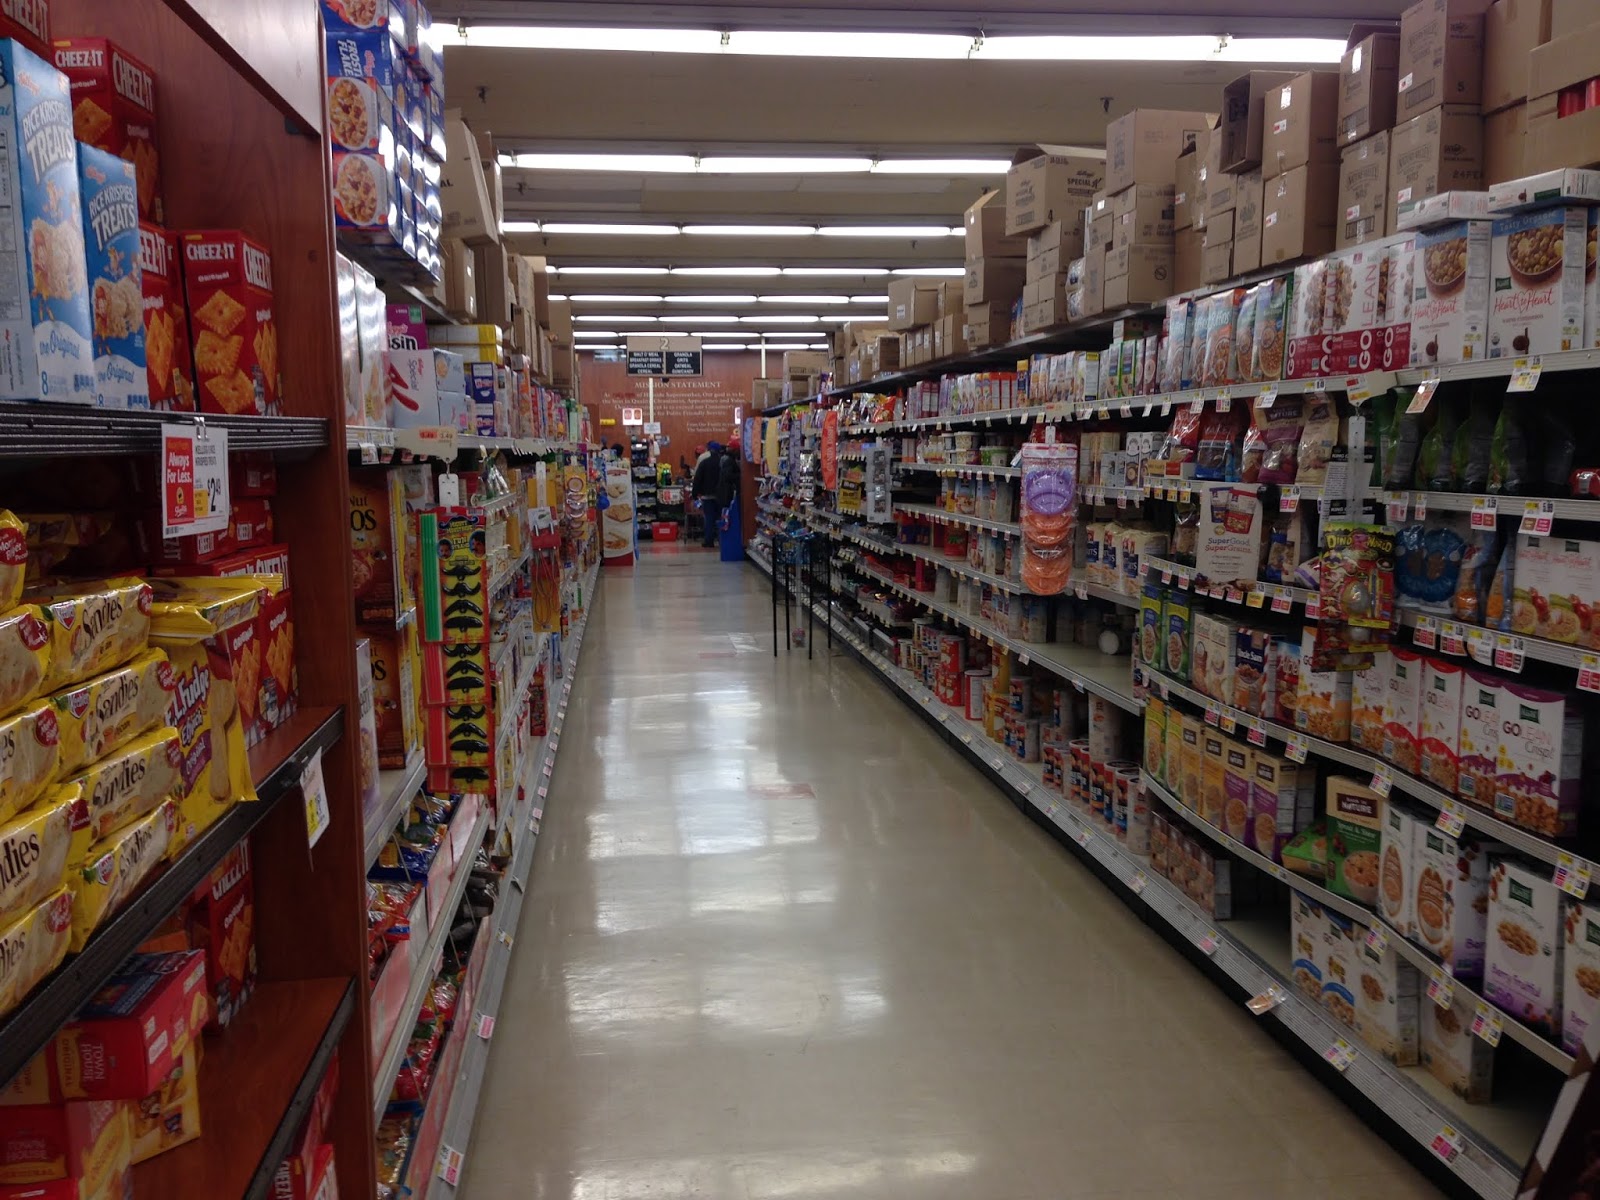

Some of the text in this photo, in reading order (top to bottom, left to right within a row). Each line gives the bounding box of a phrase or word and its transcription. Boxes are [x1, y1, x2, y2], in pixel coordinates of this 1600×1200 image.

[336, 40, 354, 78] FLAKE
[345, 39, 363, 78] FROST
[22, 100, 71, 141] RICE KRISPIES
[26, 124, 74, 184] TREATS
[1067, 177, 1091, 186] SPECIAL
[88, 184, 134, 220] RICE KRISPIES
[91, 203, 136, 251] TREATS
[1362, 263, 1377, 328] LEAN
[1493, 291, 1521, 316] Heart
[1528, 287, 1555, 308] Heart
[50, 330, 80, 359] Original
[387, 335, 418, 350] isin
[660, 336, 670, 351] 2
[1359, 329, 1372, 370] GO
[1383, 327, 1394, 368] GO
[1287, 339, 1297, 376] GO
[41, 371, 49, 396] 8
[634, 381, 670, 389] MISION
[167, 468, 177, 483] For
[168, 451, 190, 471] Always
[1207, 536, 1250, 547] SuperGood
[1325, 533, 1353, 550] DINO
[1250, 651, 1263, 663] Sam
[1278, 656, 1300, 676] Alpe
[1341, 800, 1373, 814] NATURE
[80, 1043, 93, 1082] HOUSE
[92, 1043, 105, 1081] TOWN
